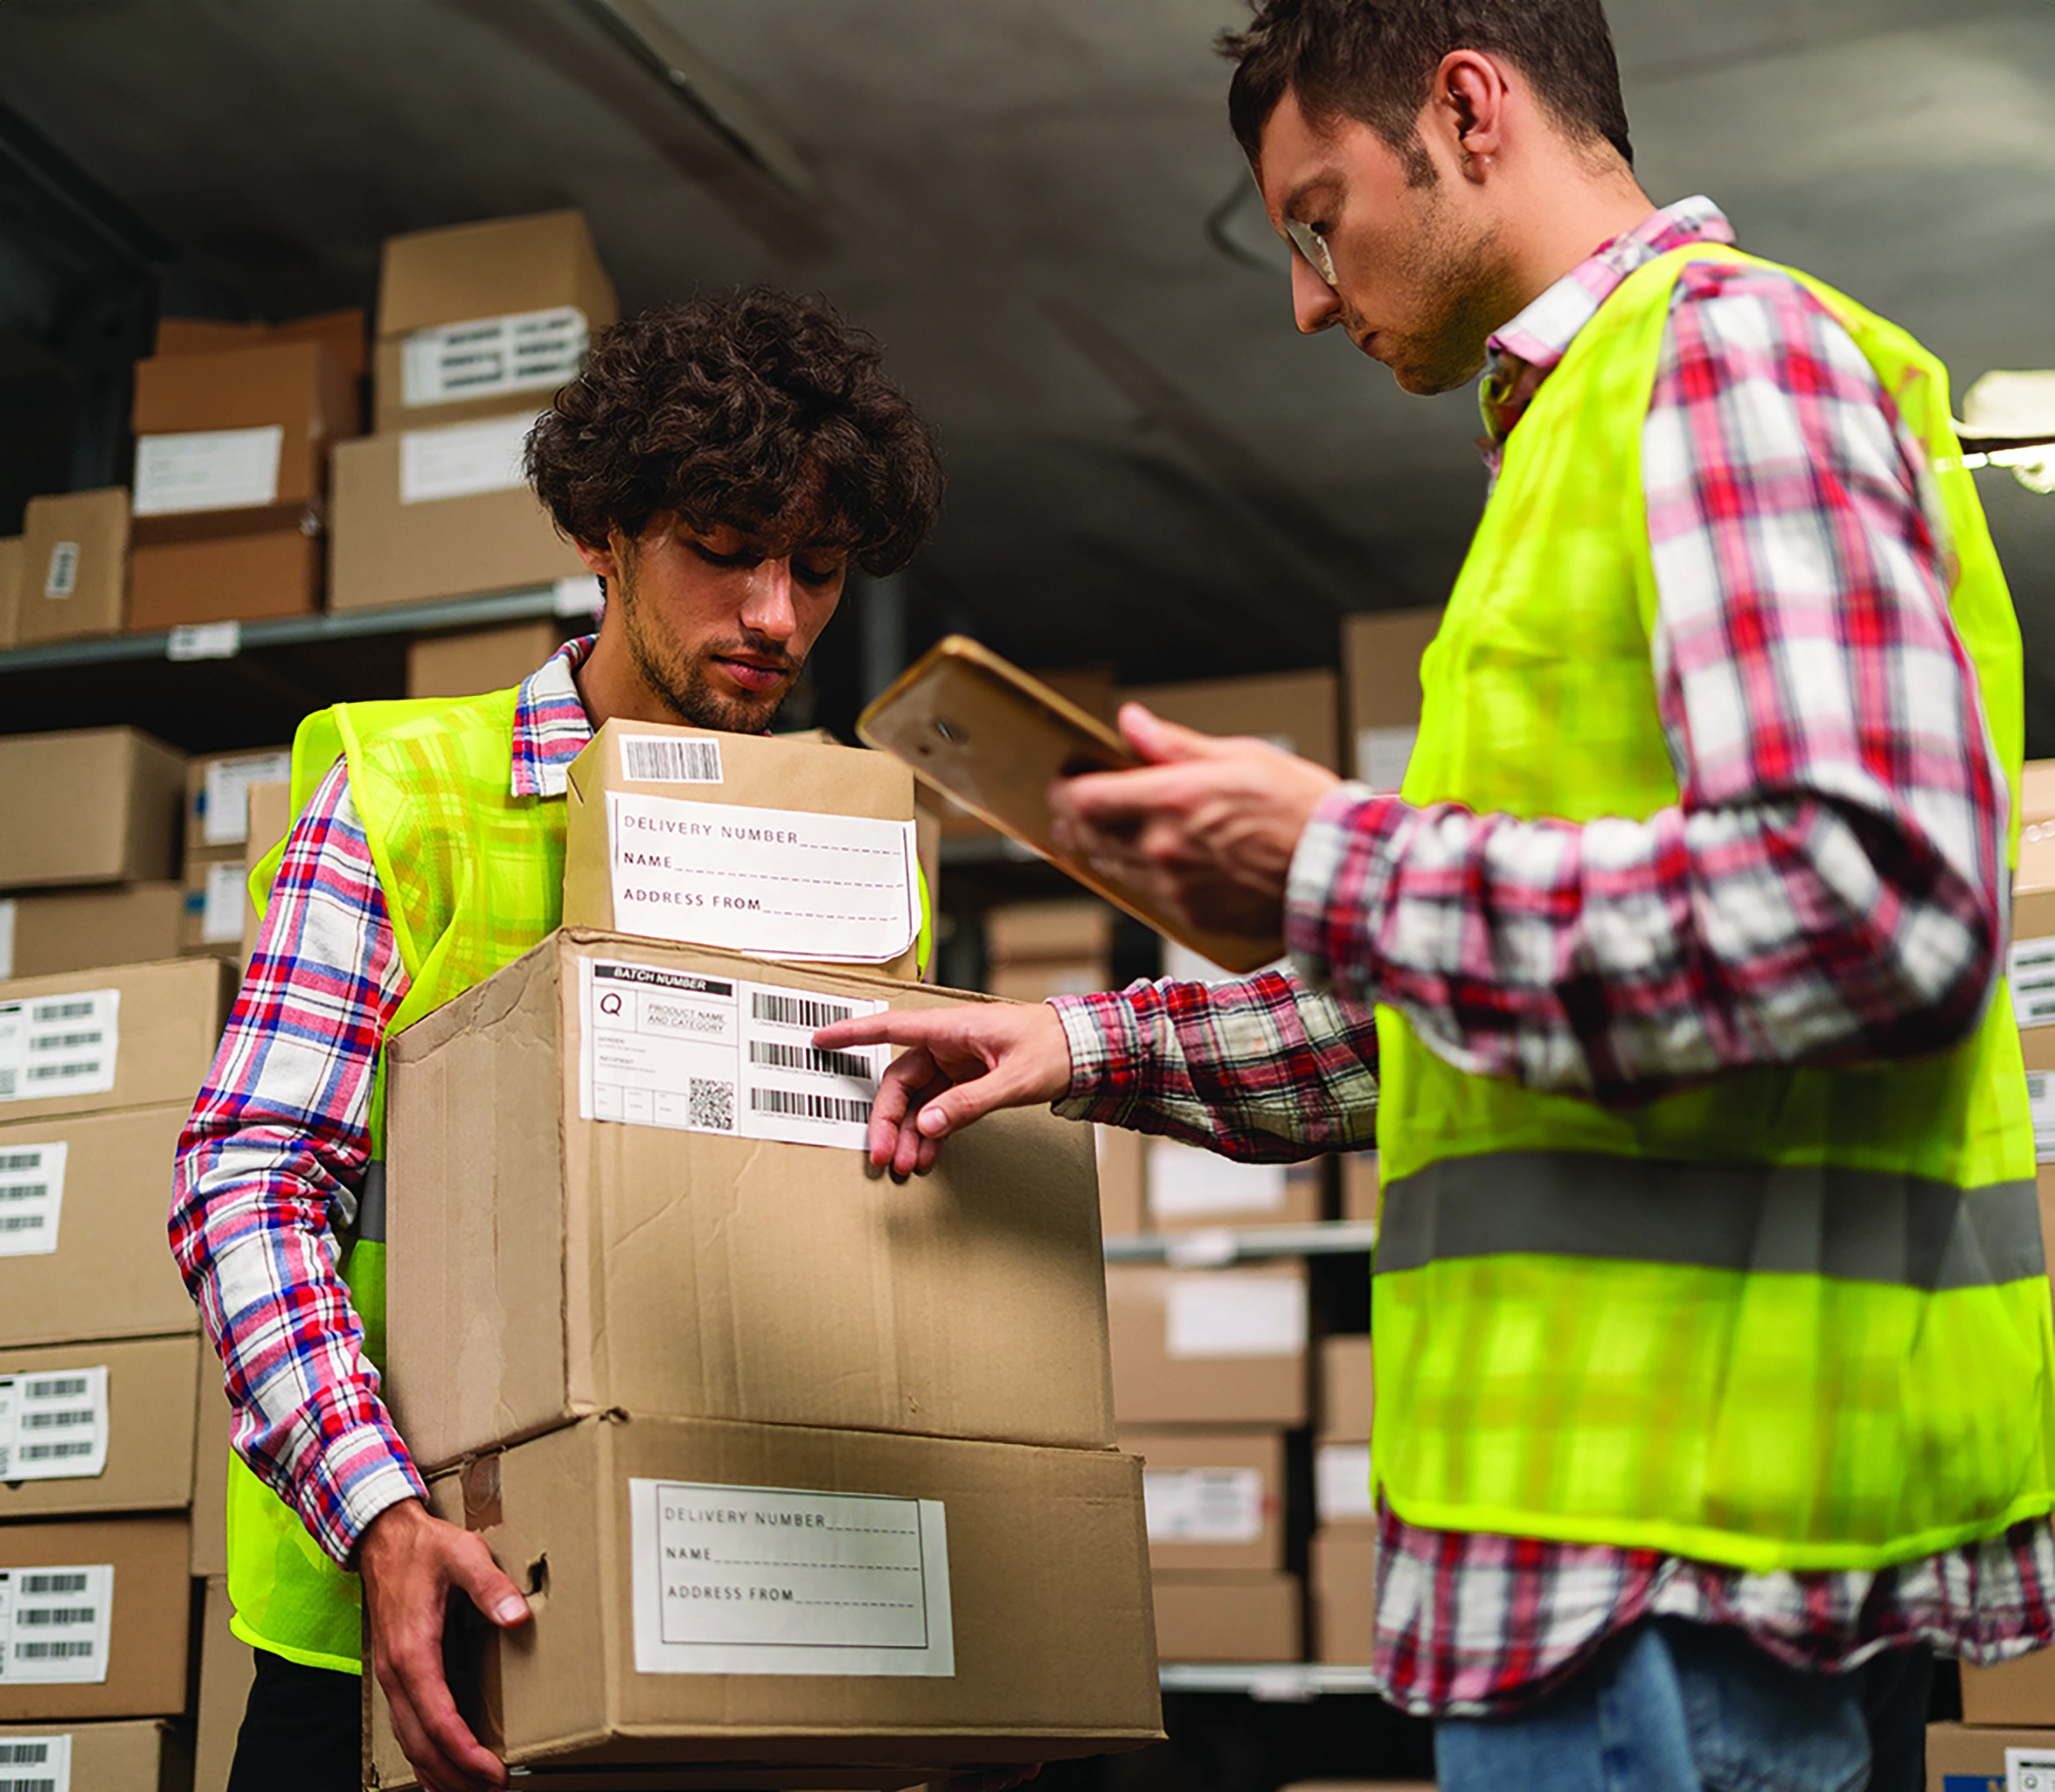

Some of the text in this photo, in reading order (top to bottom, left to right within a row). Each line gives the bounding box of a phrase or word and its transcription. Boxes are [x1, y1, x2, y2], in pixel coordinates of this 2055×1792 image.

[624, 815, 798, 844] DELIVERY NUMBER
[624, 852, 672, 868] NAME
[624, 888, 761, 911] ADDRESS FROM
[613, 966, 707, 991] BATCH NUMBER
[600, 993, 622, 1017] Q
[648, 1004, 726, 1022] PRODUCT NAME
[647, 1015, 725, 1032] AND CATEGORY
[665, 1507, 825, 1528] DELIVERY NUMBER
[666, 1547, 711, 1561] NAME
[668, 1585, 793, 1601] ADDRESS FROM
